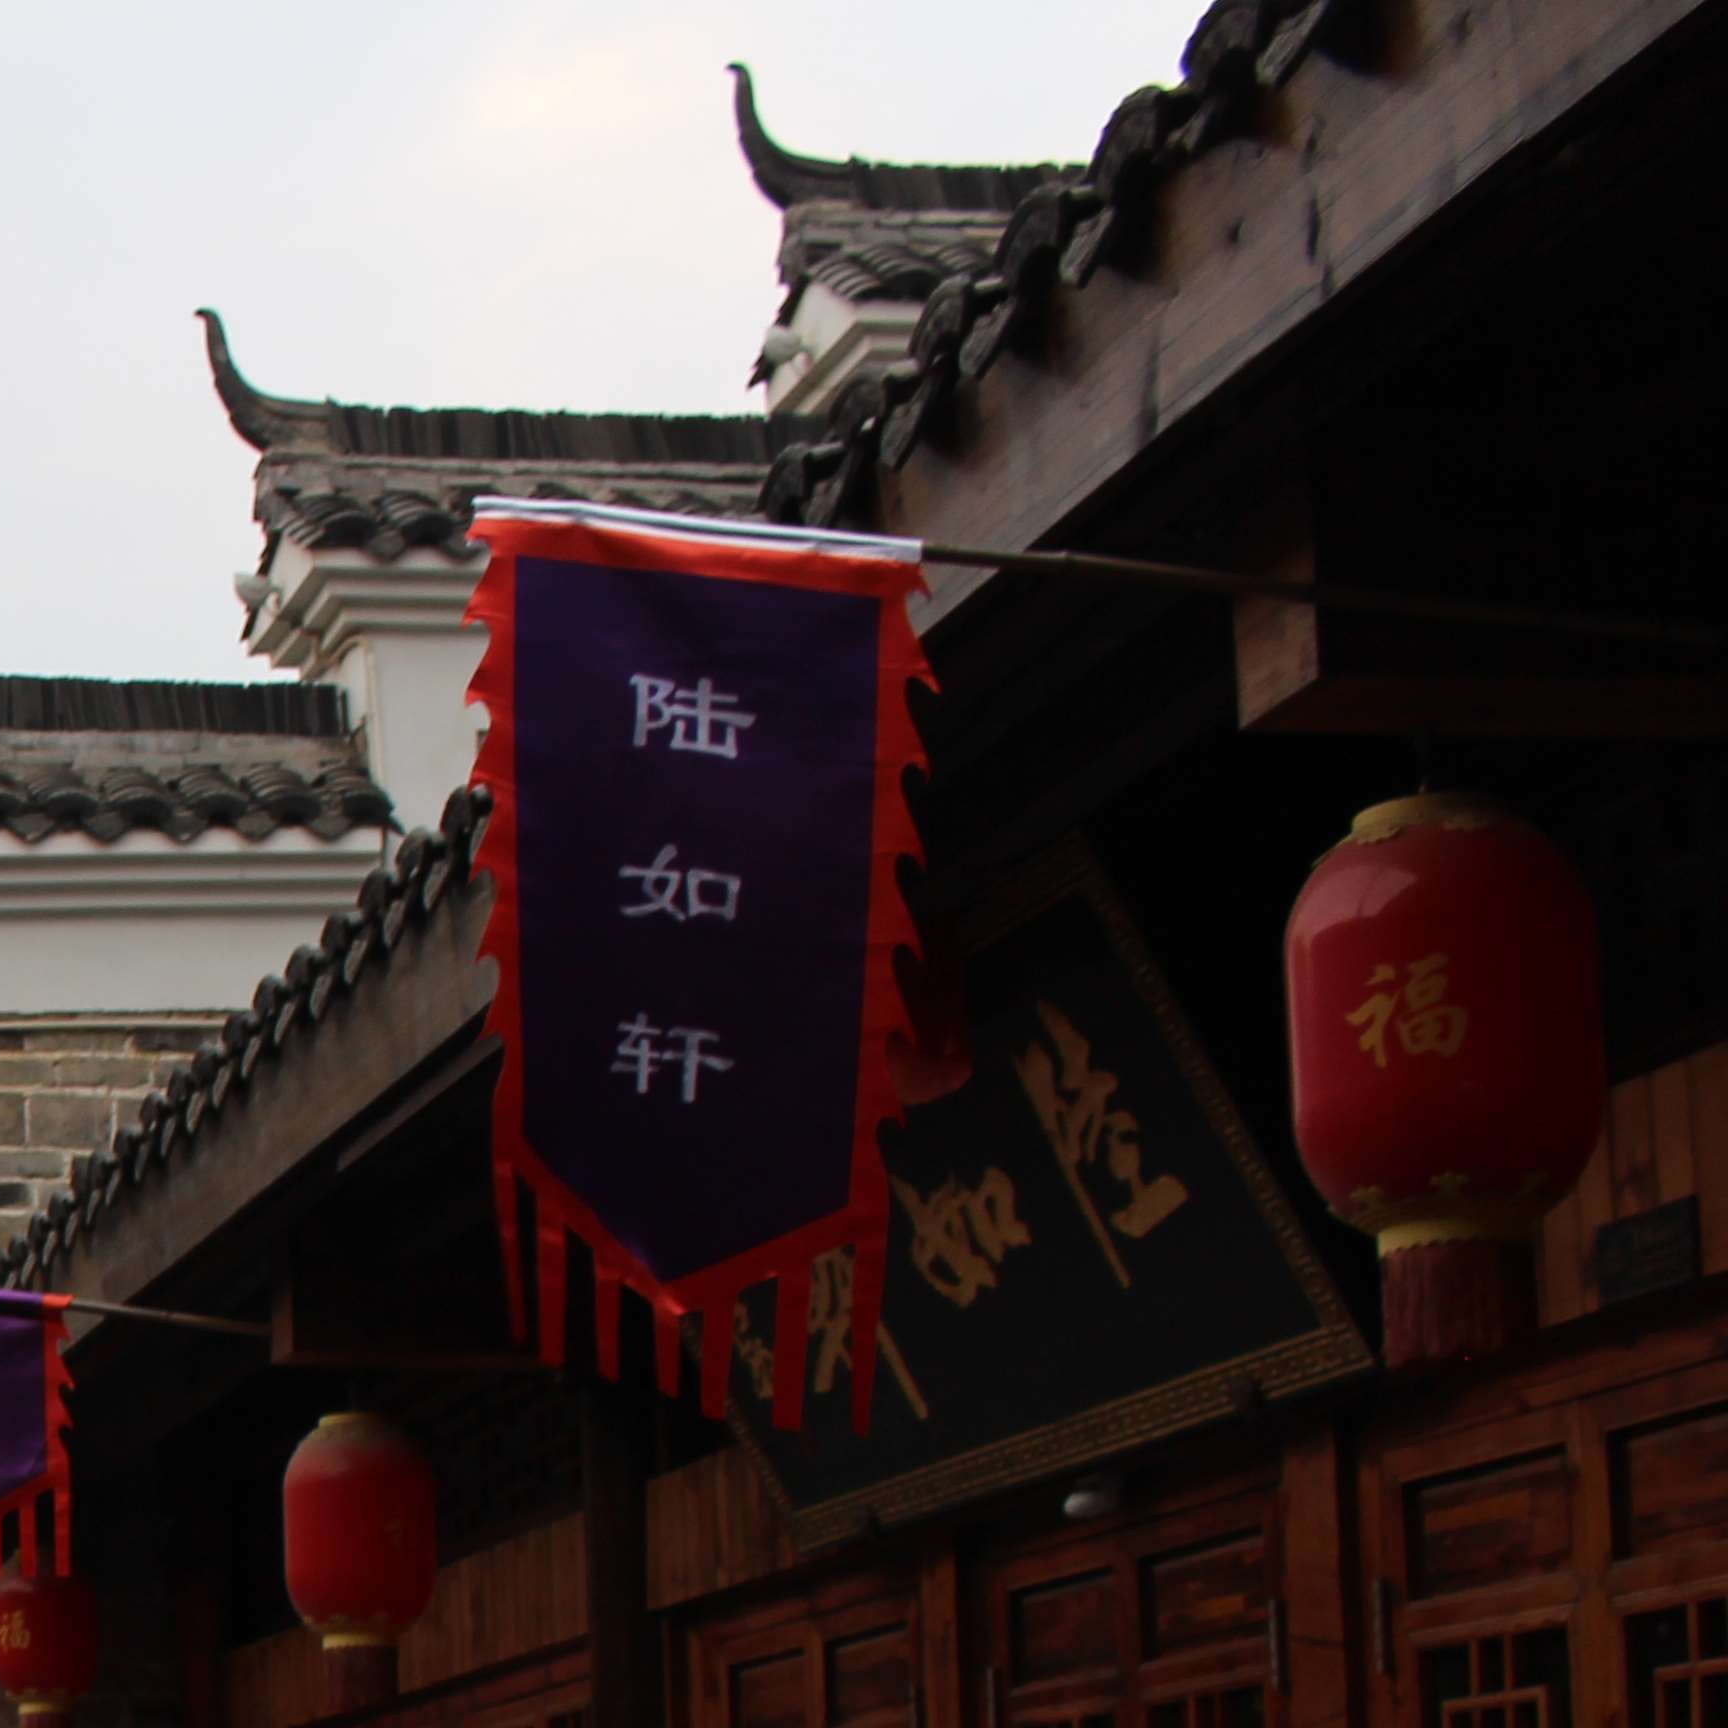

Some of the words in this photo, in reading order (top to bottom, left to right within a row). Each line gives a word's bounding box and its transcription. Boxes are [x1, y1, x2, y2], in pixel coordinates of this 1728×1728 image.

[608, 672, 757, 1104] 陆如轩
[1347, 950, 1472, 1071] 福
